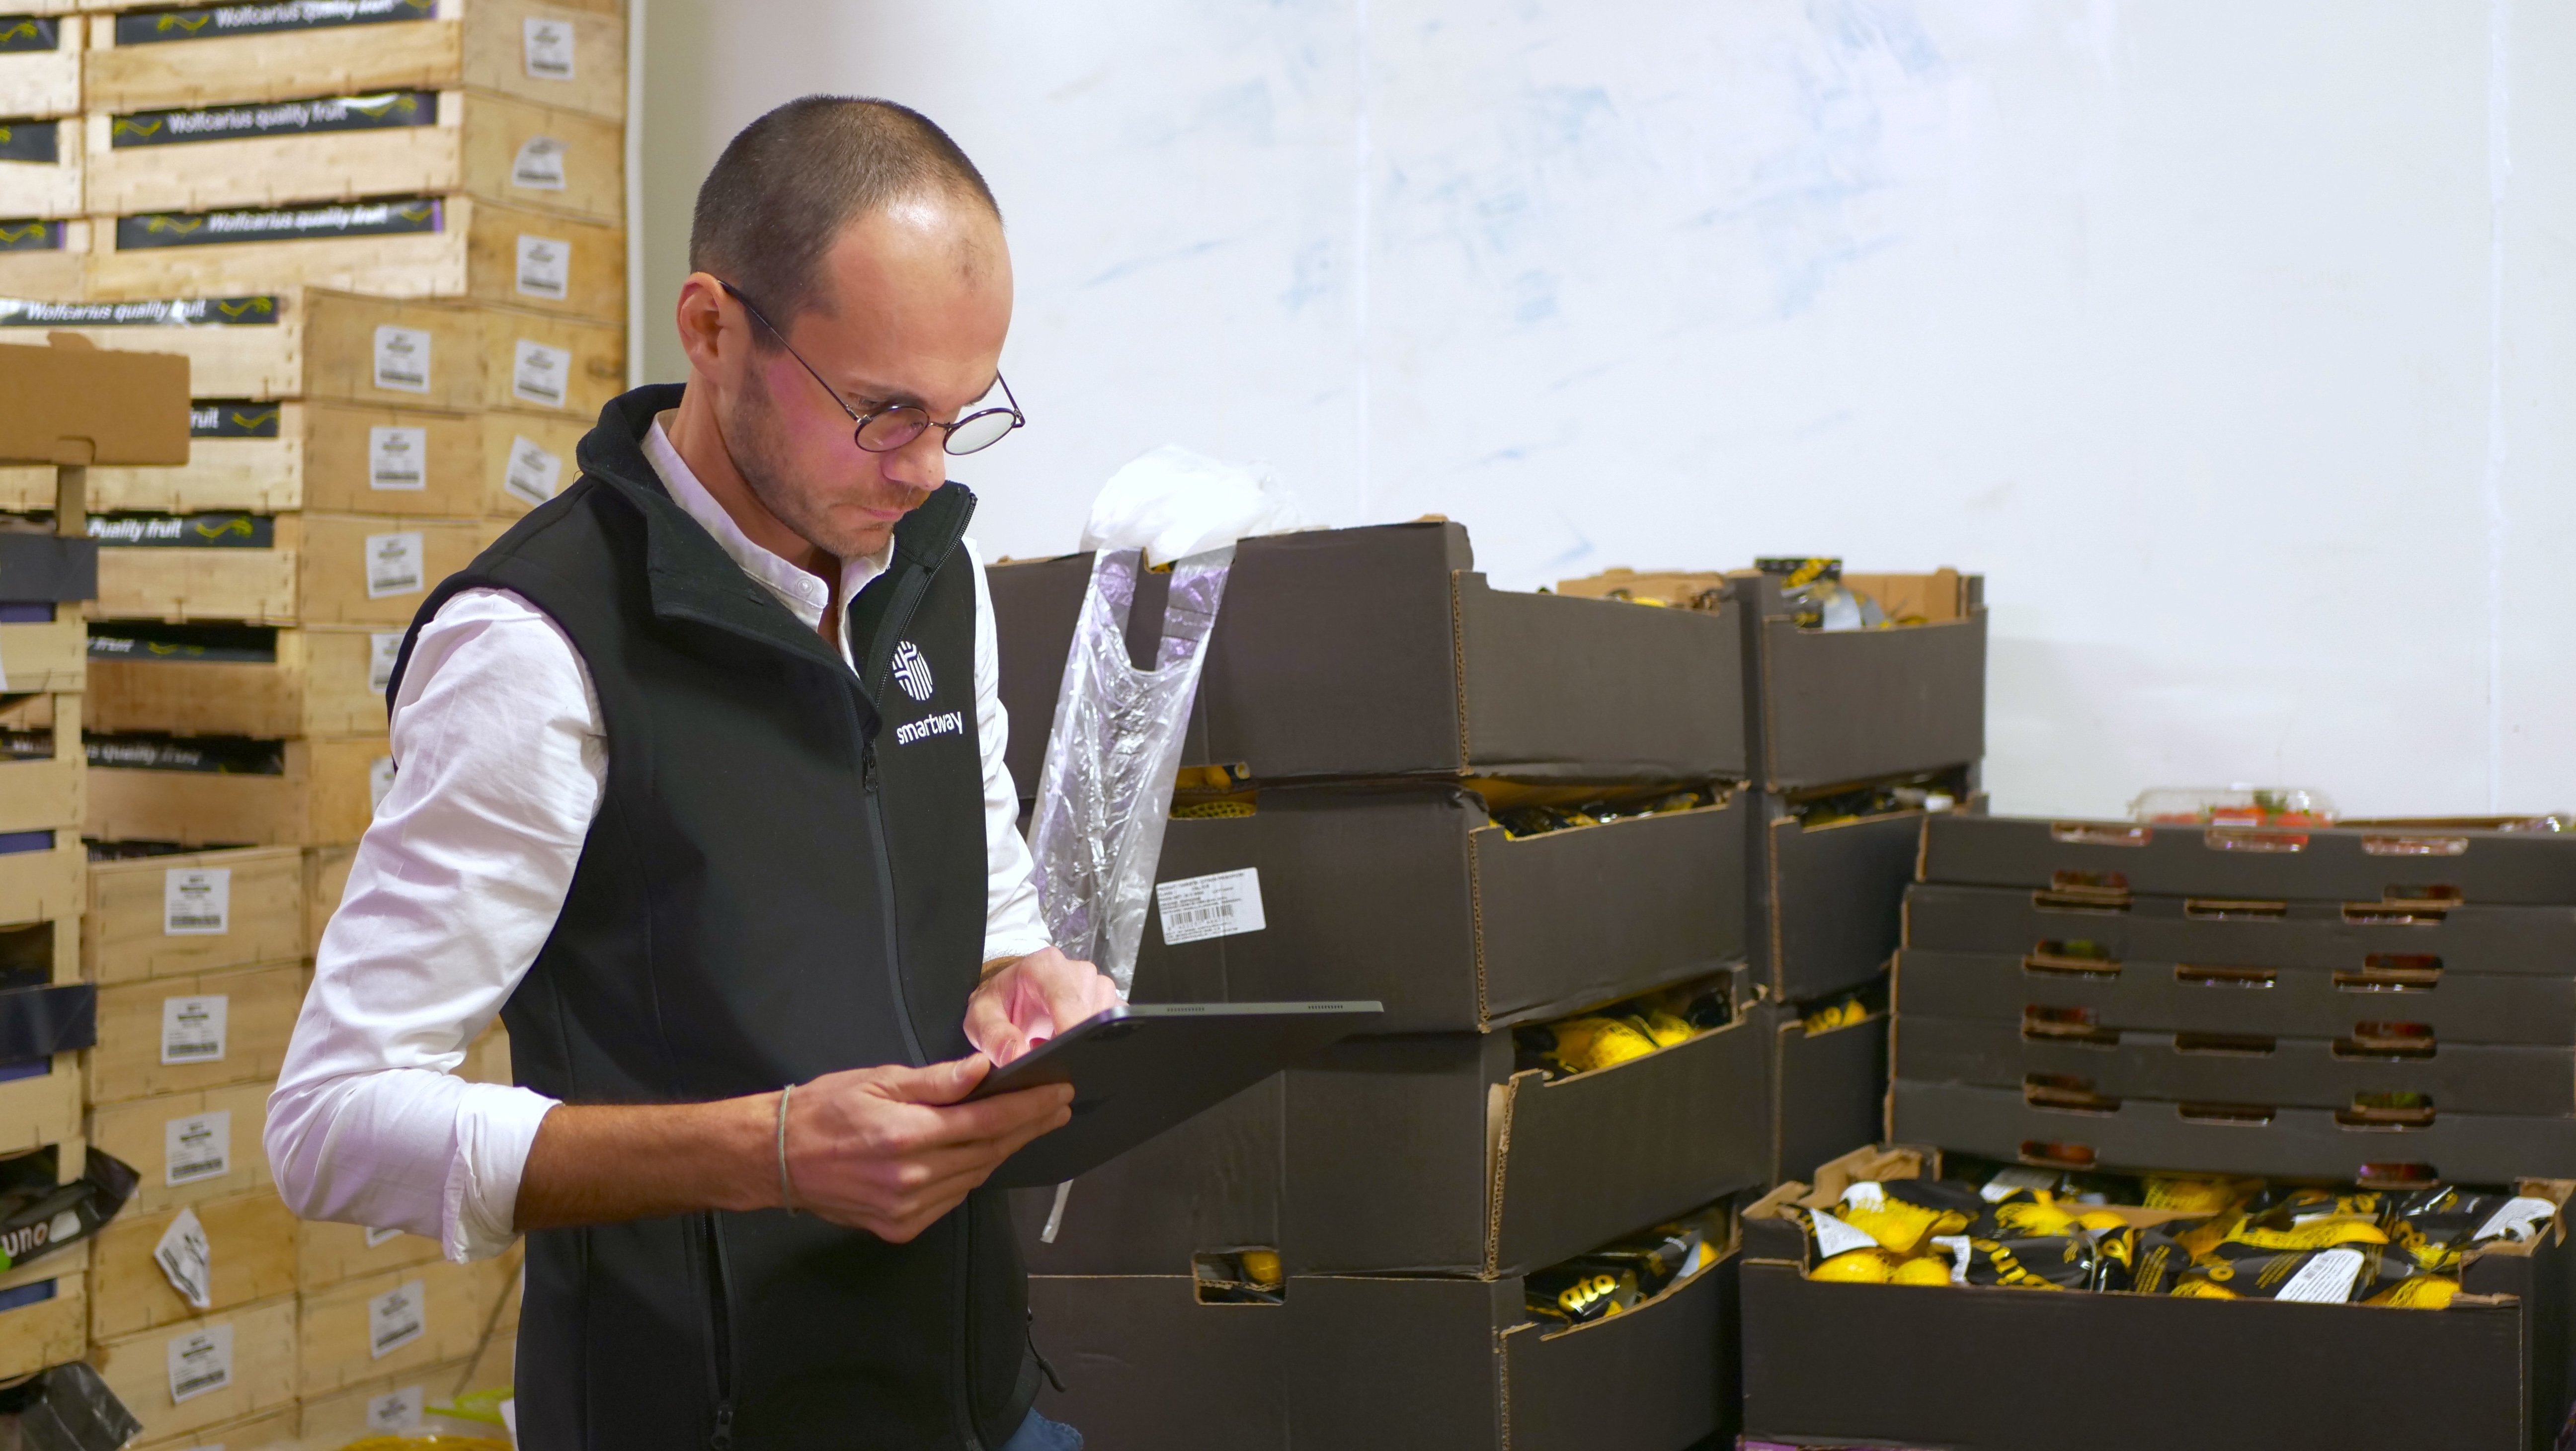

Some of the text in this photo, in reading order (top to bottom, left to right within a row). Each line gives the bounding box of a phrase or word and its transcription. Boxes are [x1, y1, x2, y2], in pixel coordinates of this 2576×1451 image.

[215, 2, 299, 28] Wolfcarius
[167, 100, 348, 134] Wolfcarius quality fruit
[208, 211, 294, 233] Wolfcarius
[295, 206, 351, 232] quality
[26, 301, 113, 321] Wolfcarius
[113, 300, 169, 323] quality
[191, 406, 219, 429] ruit
[146, 517, 183, 539] fruit
[896, 711, 963, 745] smartway
